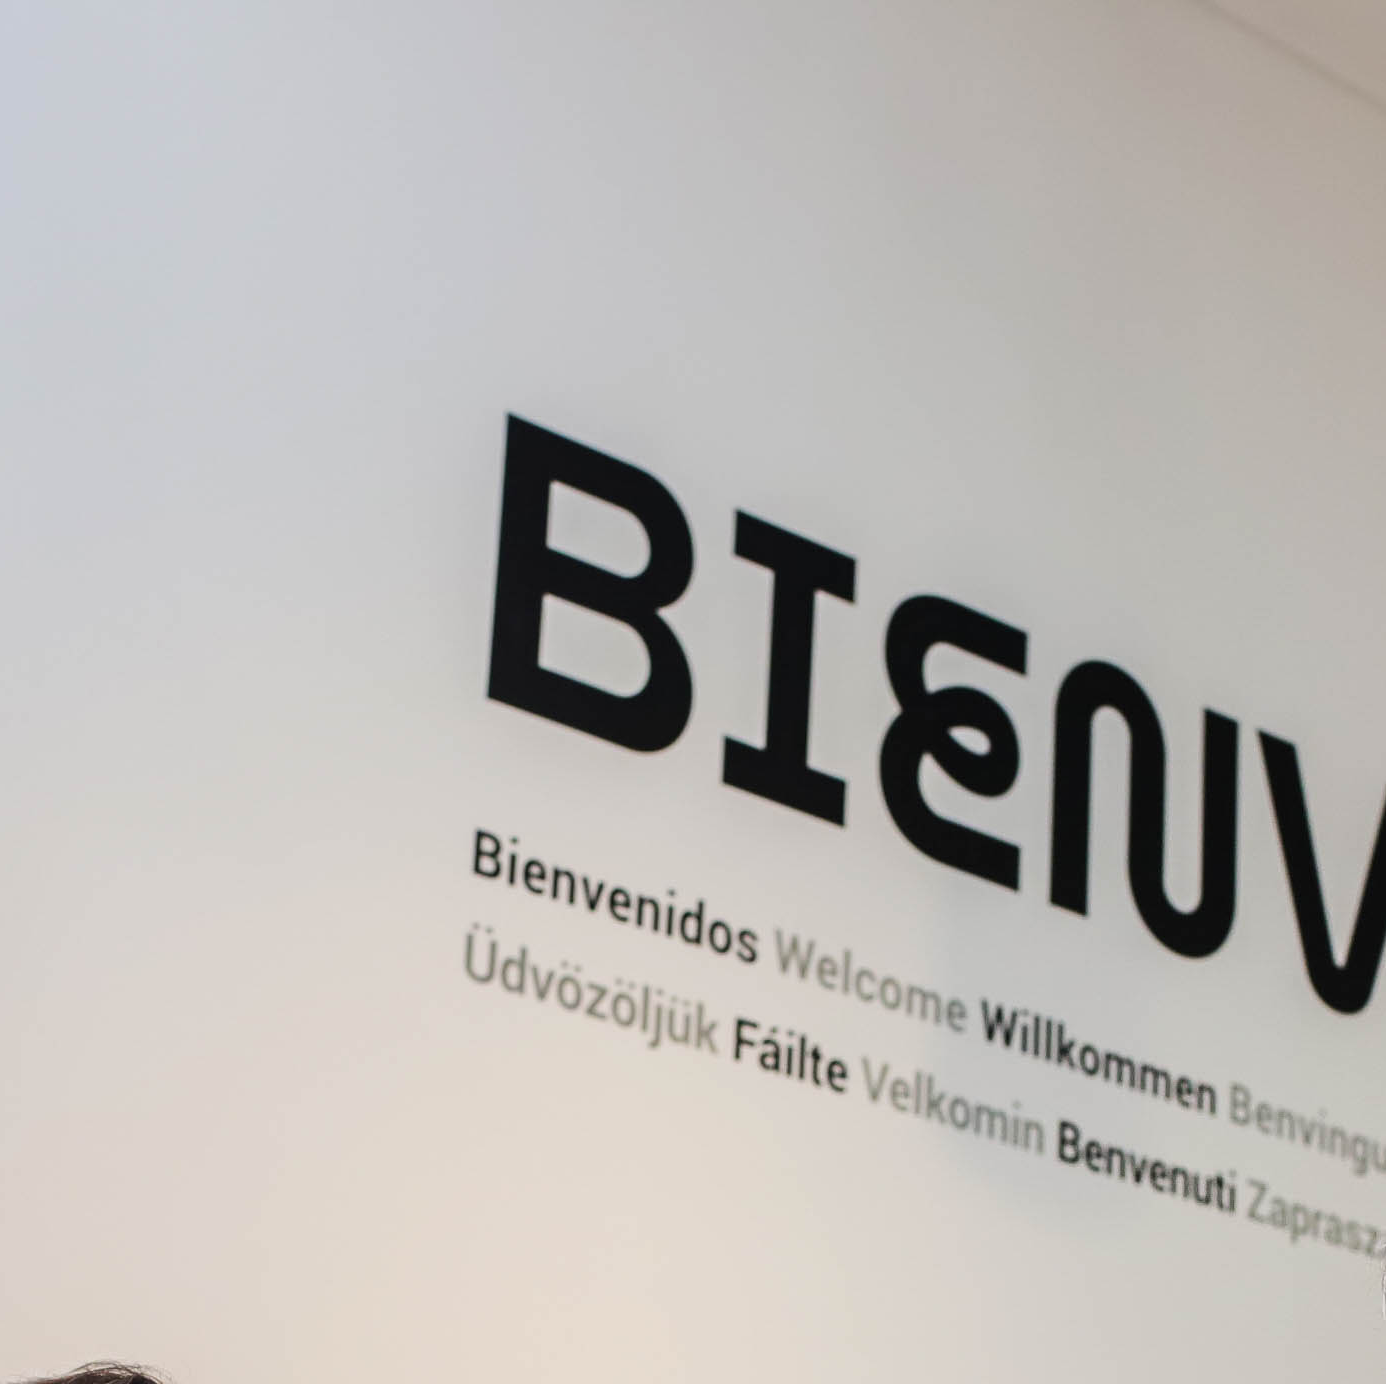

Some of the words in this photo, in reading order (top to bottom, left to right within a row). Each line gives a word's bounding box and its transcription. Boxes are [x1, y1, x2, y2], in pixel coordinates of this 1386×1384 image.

[463, 922, 718, 1053] Üdvözöljük
[732, 1017, 849, 1094] Fáilte
[861, 1057, 1046, 1157] Velkomin
[1057, 1119, 1238, 1214] Benvenuti
[1247, 1178, 1383, 1257] Zaprasz
[471, 828, 760, 964] Bienvenidos
[774, 929, 969, 1034] Welcome
[979, 999, 1216, 1116] Willkommen
